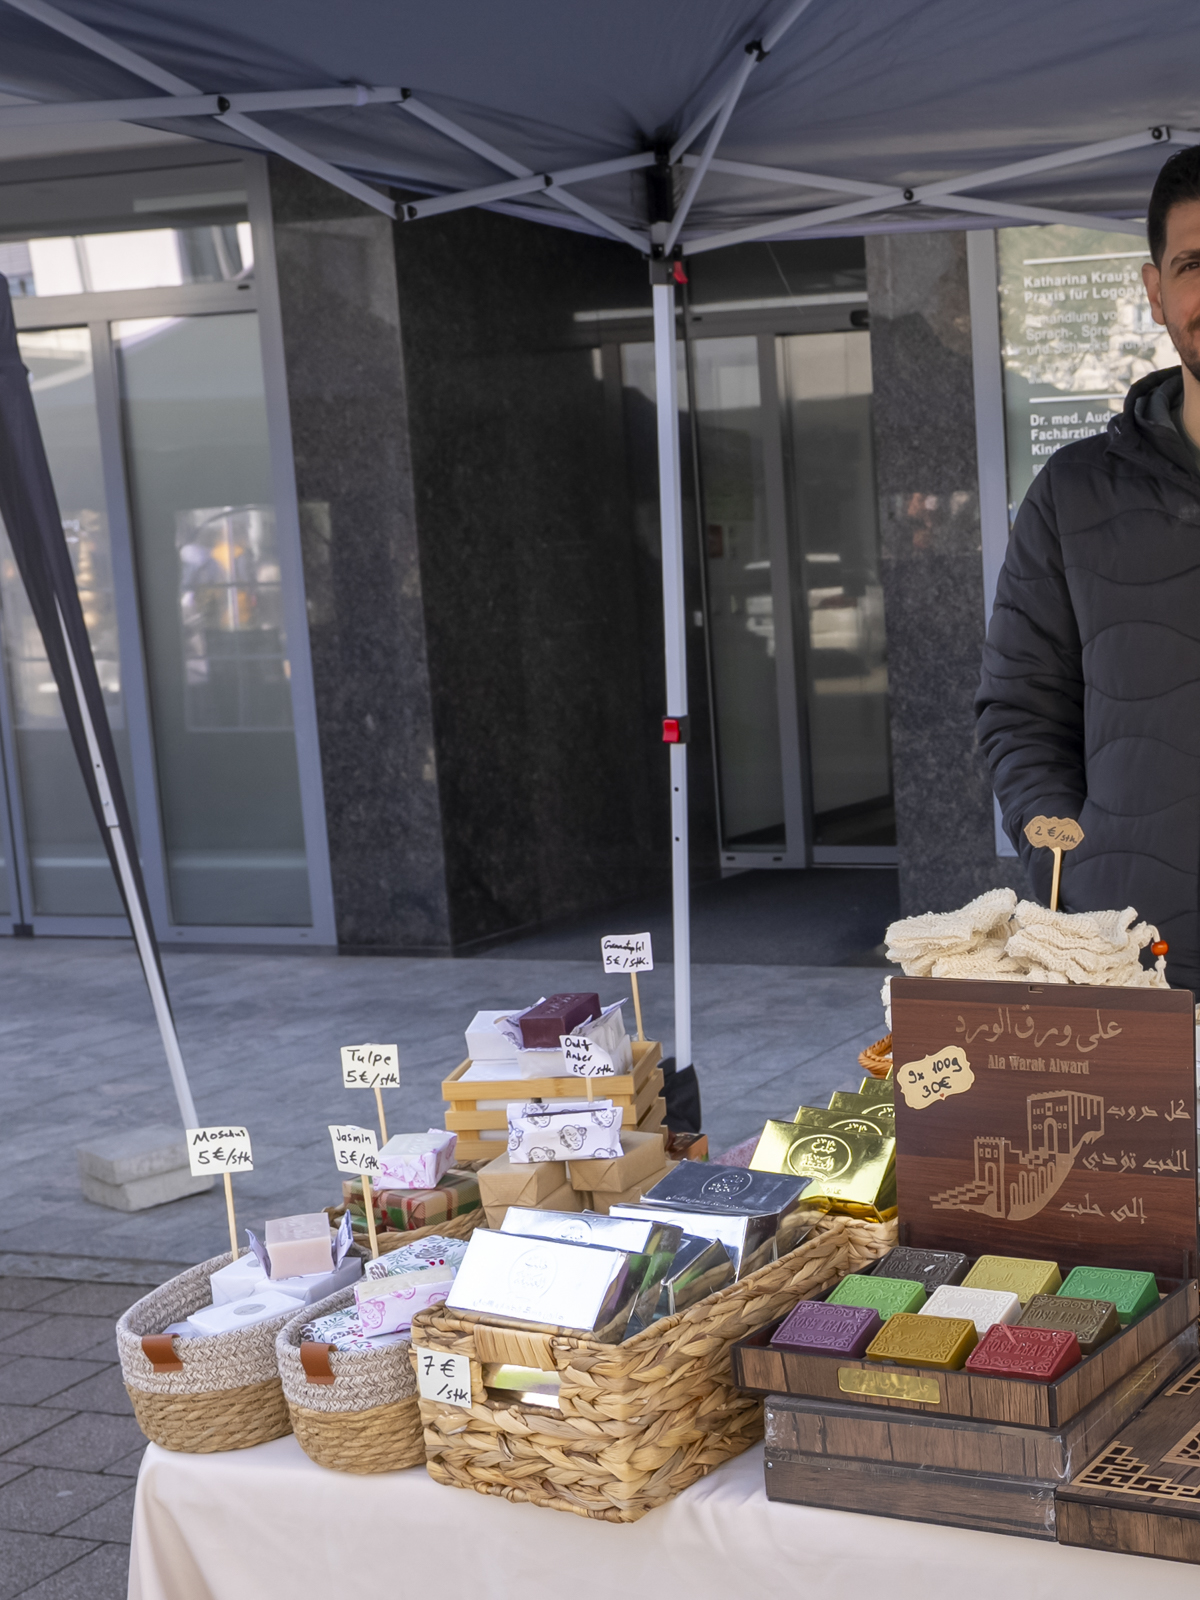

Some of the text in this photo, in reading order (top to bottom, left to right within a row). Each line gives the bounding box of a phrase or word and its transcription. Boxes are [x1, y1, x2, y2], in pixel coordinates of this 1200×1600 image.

[1023, 270, 1139, 288] Katharina Krause
[1024, 290, 1066, 303] Praxis
[1070, 288, 1089, 300] für
[1030, 414, 1049, 427] Dr.
[1051, 412, 1082, 425] med.
[1030, 427, 1097, 441] Fachärztin
[955, 1004, 1123, 1053] على ورق الورد
[346, 1048, 392, 1067] Tulpe
[988, 1054, 1090, 1075] Ala Warak Alward
[1164, 1098, 1191, 1122] كل
[336, 1128, 372, 1145] Jasmin
